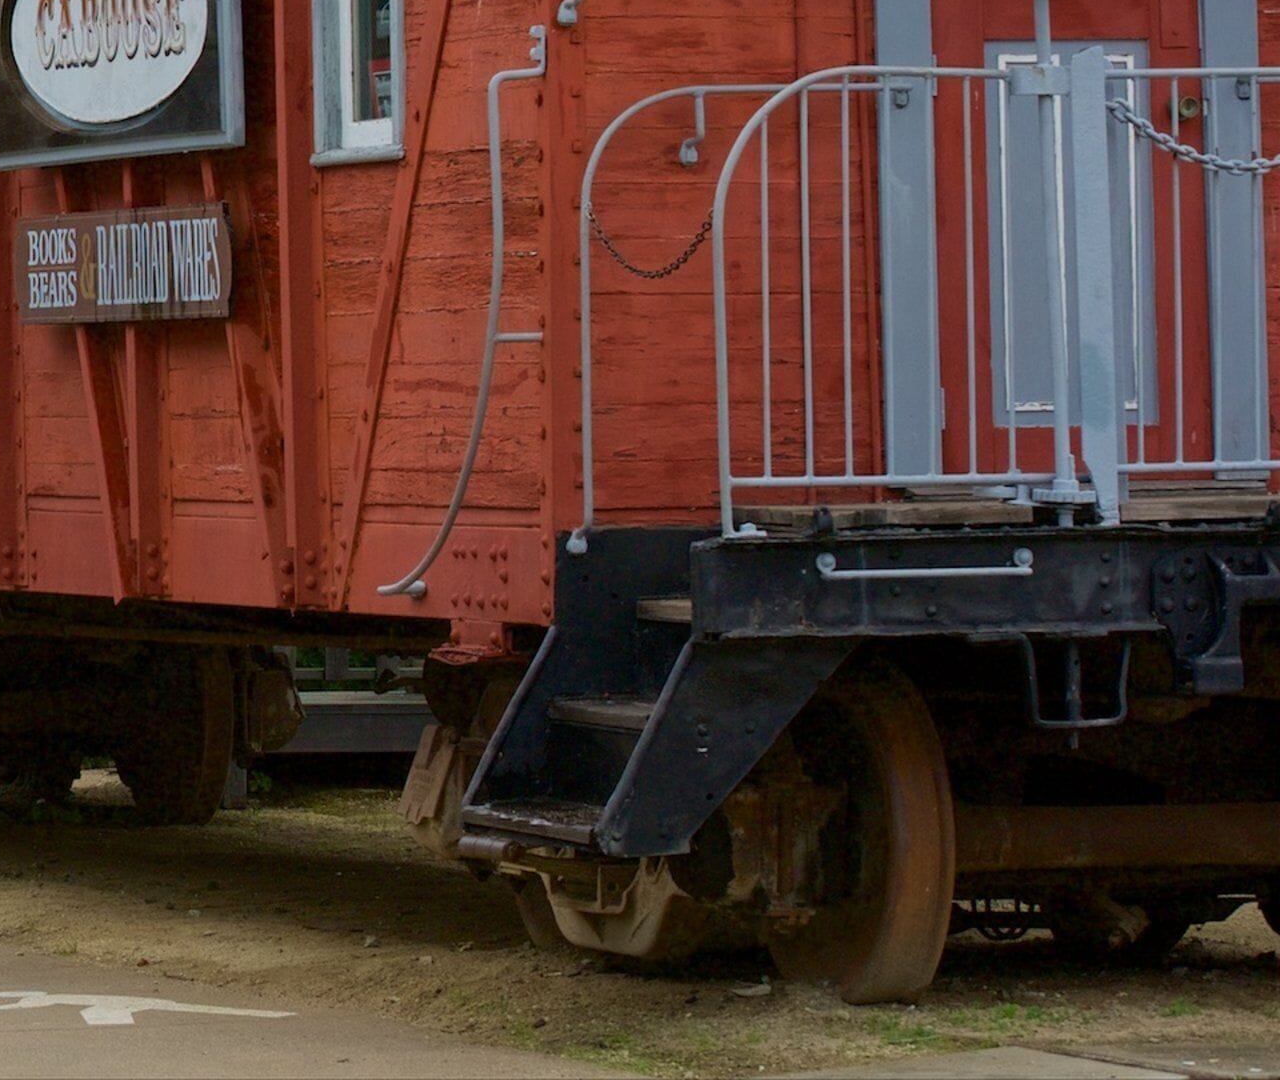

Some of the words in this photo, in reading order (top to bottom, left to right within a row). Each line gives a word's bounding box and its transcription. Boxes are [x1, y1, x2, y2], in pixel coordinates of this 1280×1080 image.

[27, 228, 77, 266] BOOKS
[80, 232, 97, 300] &
[96, 221, 169, 306] RAILROAD
[169, 217, 221, 302] WARES
[28, 271, 77, 309] BEARS
